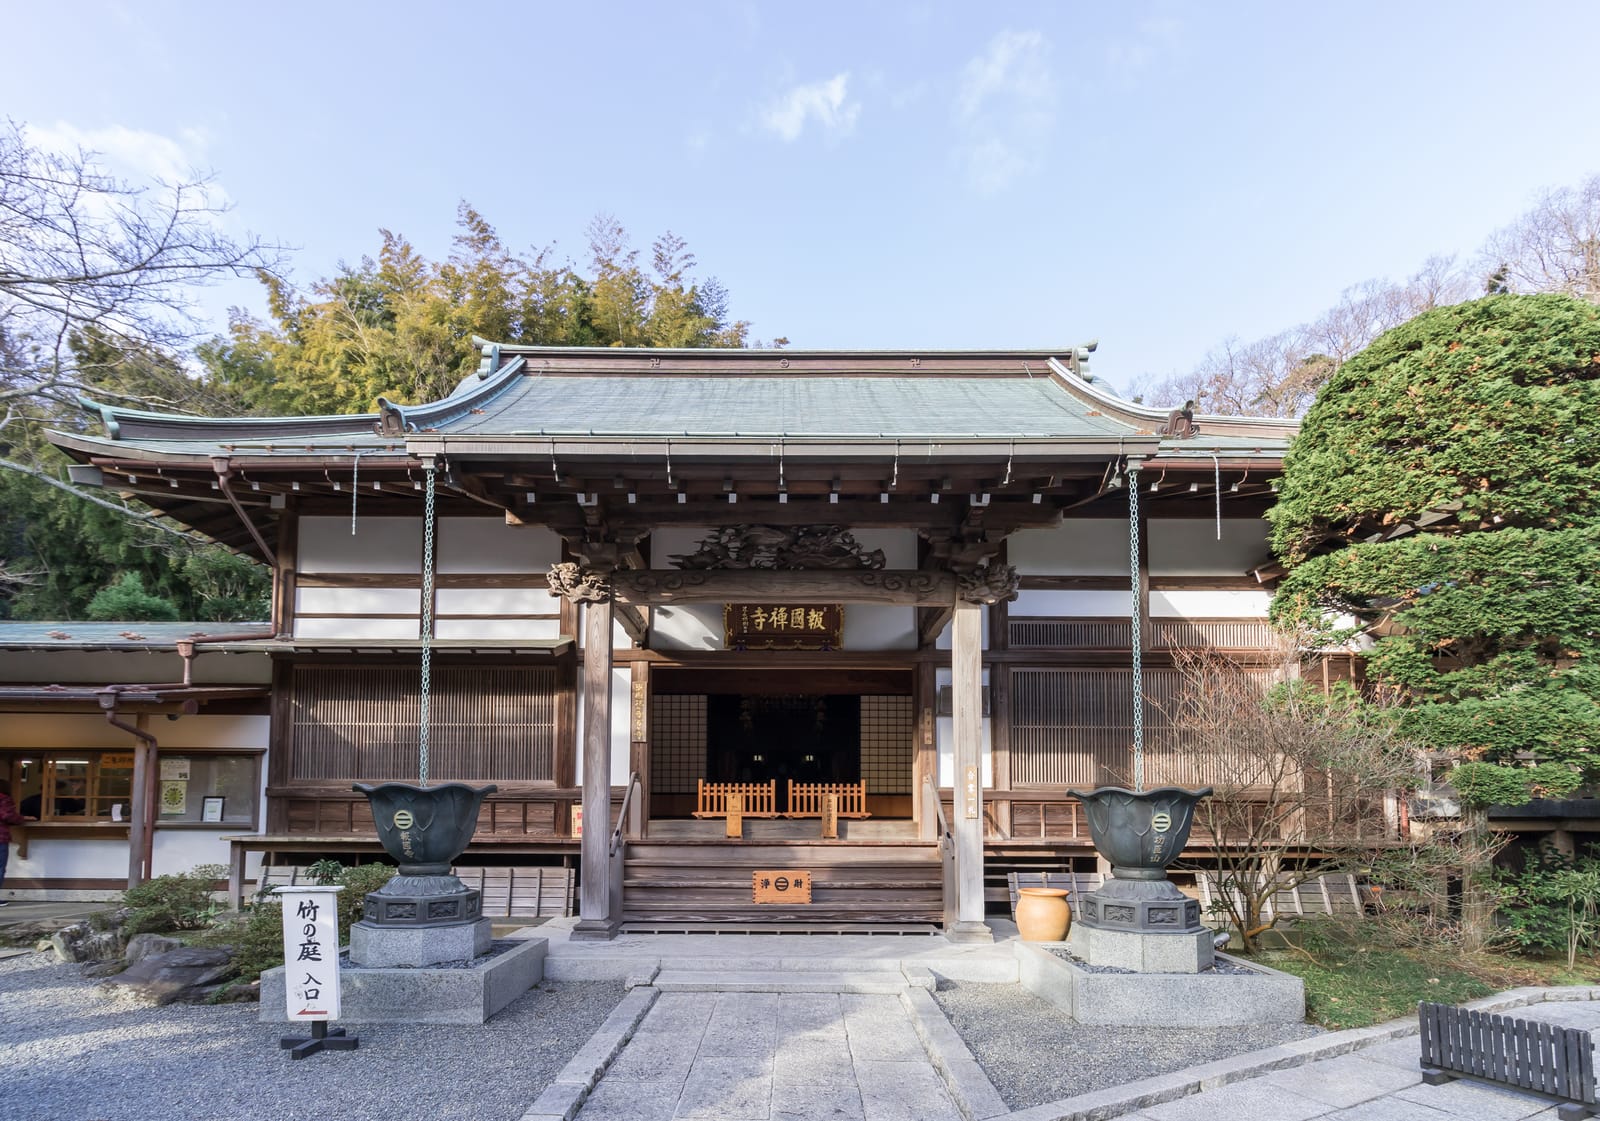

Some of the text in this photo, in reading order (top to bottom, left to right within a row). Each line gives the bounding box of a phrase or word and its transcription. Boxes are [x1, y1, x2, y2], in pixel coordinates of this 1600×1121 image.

[297, 899, 322, 1000] 竹の庭 入口
